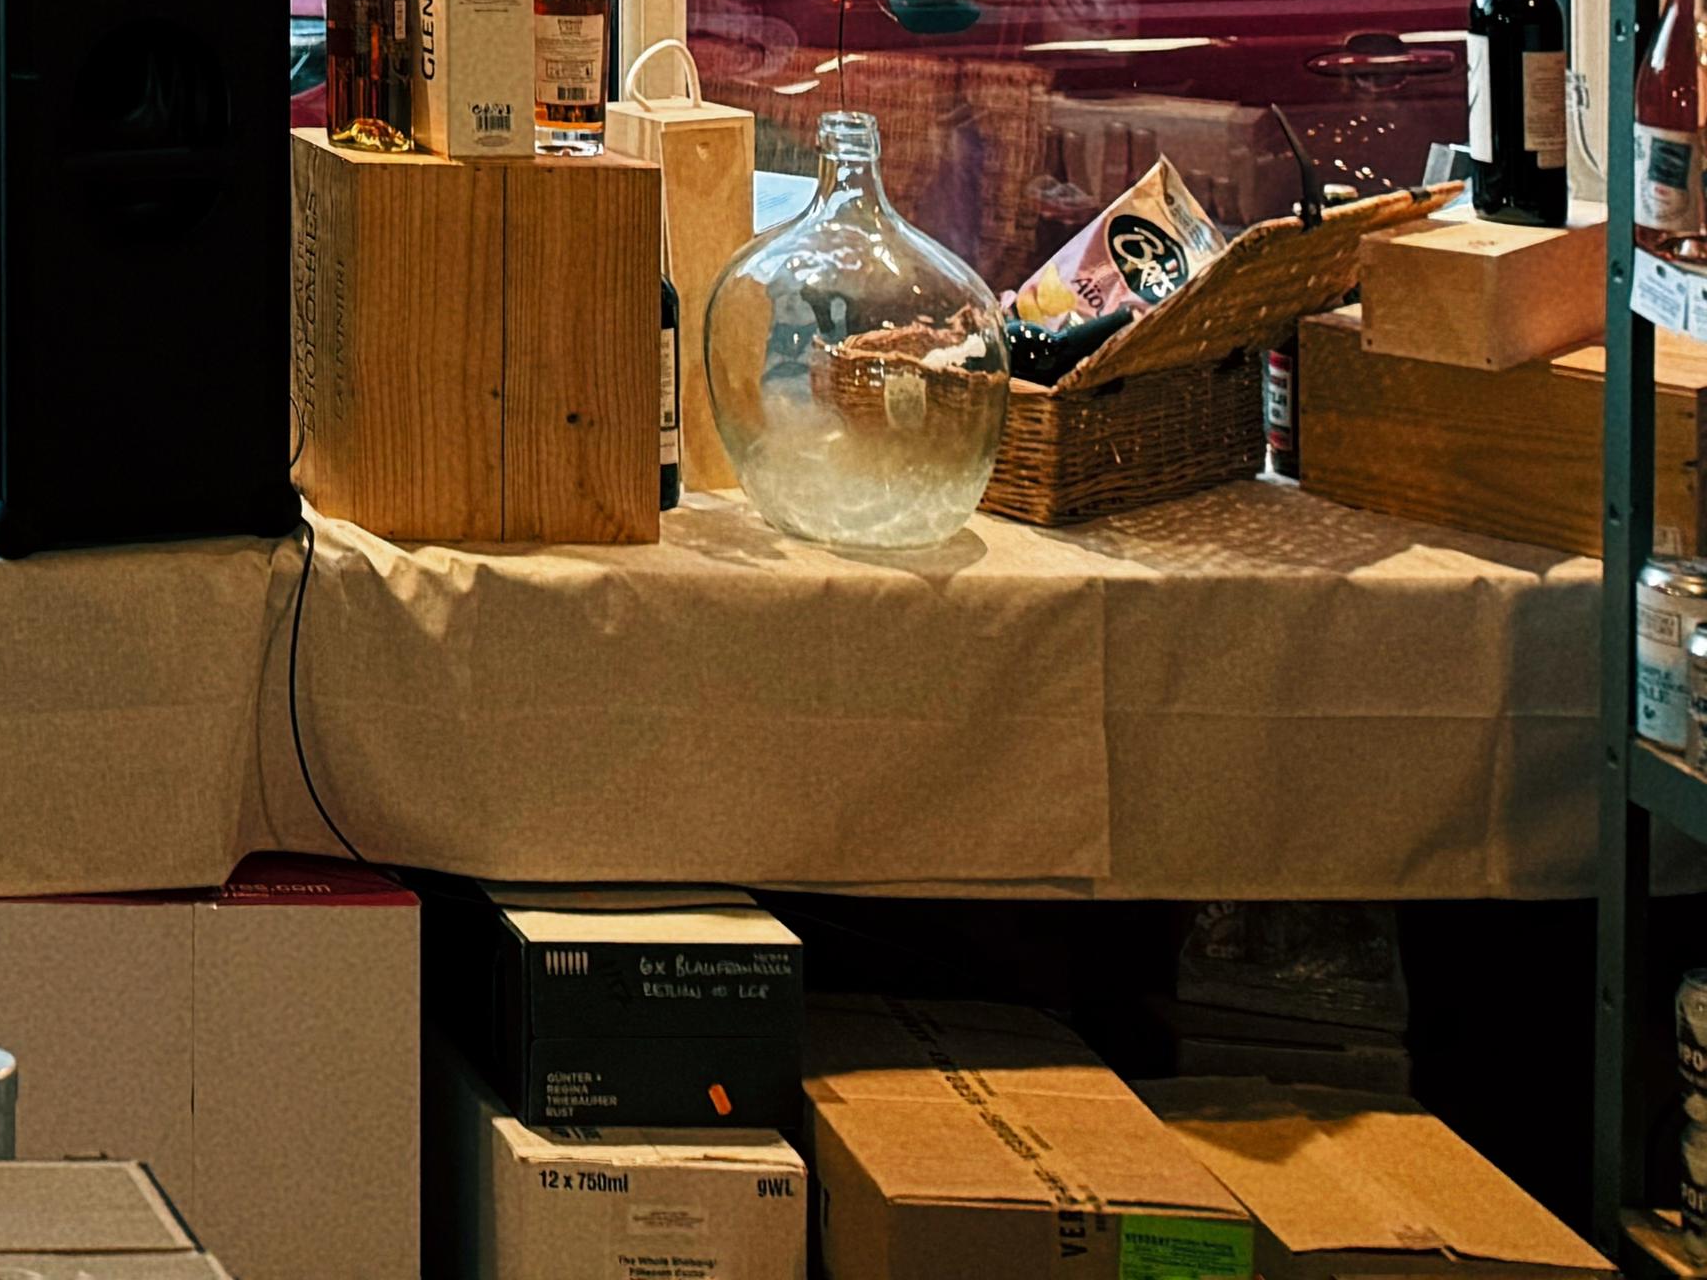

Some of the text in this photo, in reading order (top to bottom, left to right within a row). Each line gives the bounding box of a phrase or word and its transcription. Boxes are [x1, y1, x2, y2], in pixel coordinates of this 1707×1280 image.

[421, 3, 434, 80] GLEN
[539, 1170, 558, 1189] 12
[563, 1177, 573, 1190] x
[578, 1173, 628, 1192] 750ml
